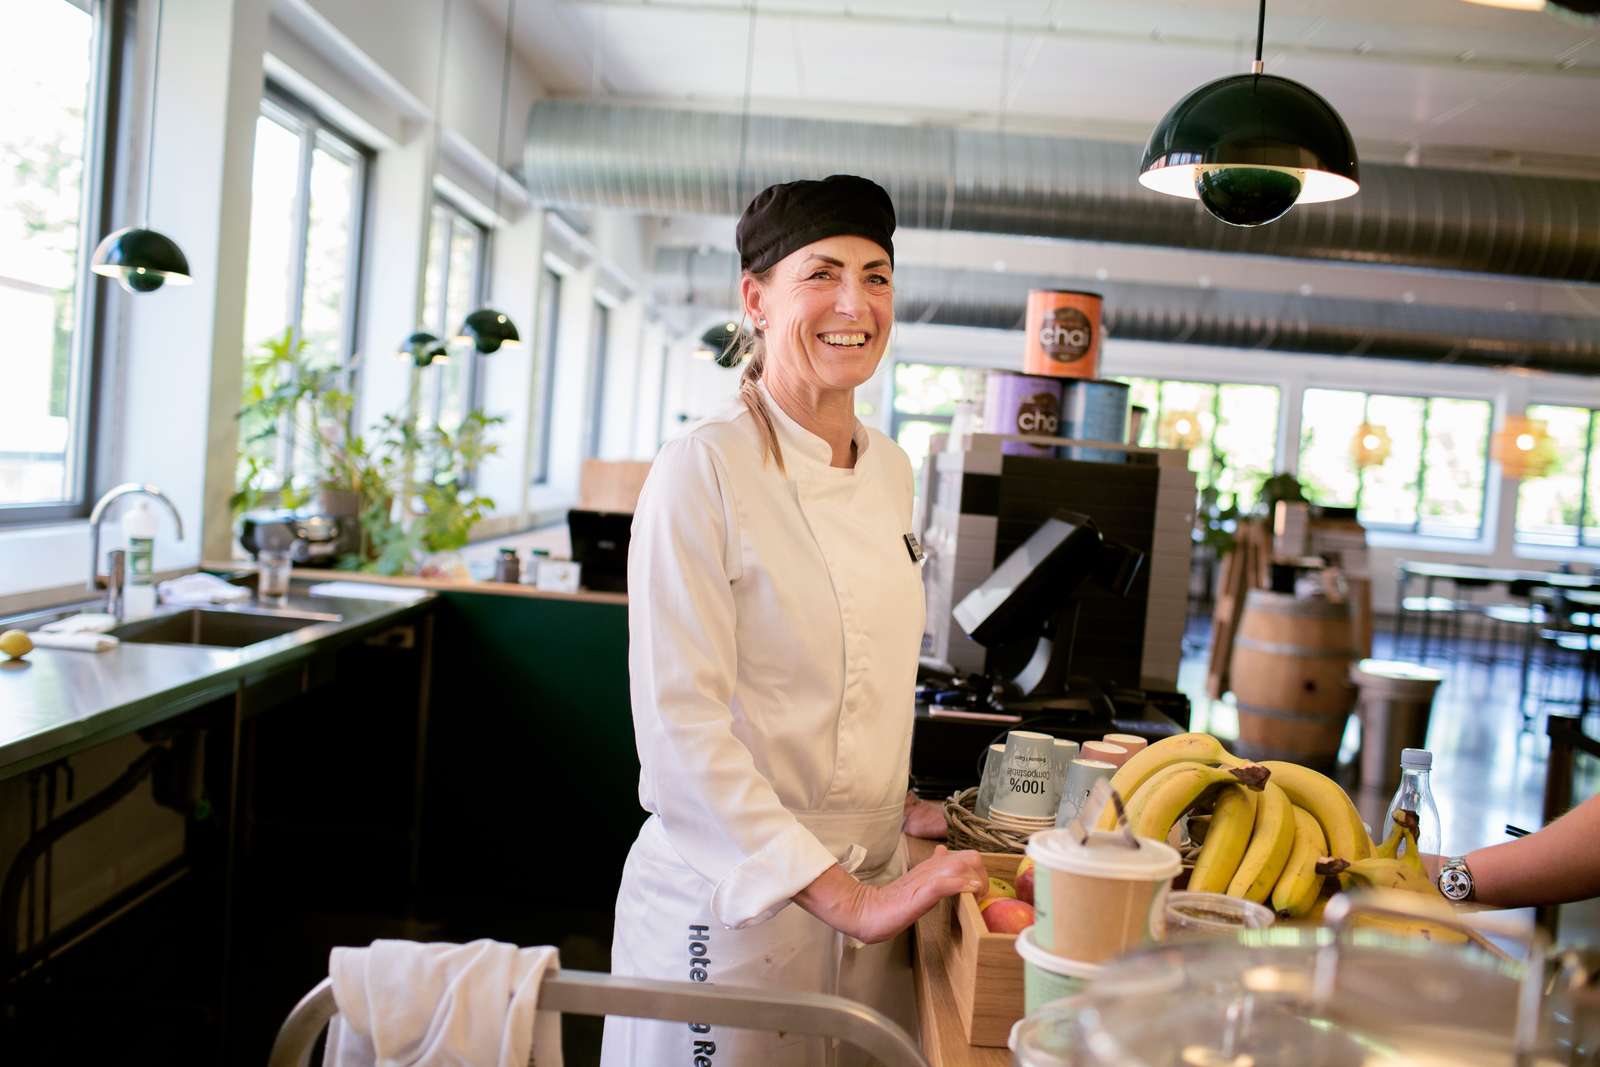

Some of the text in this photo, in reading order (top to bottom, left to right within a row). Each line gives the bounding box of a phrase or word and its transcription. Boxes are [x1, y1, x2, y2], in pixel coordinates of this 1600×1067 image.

[1018, 410, 1058, 432] cha
[1009, 777, 1046, 794] 100%
[688, 924, 714, 985] Hote
[693, 1040, 716, 1067] Re
